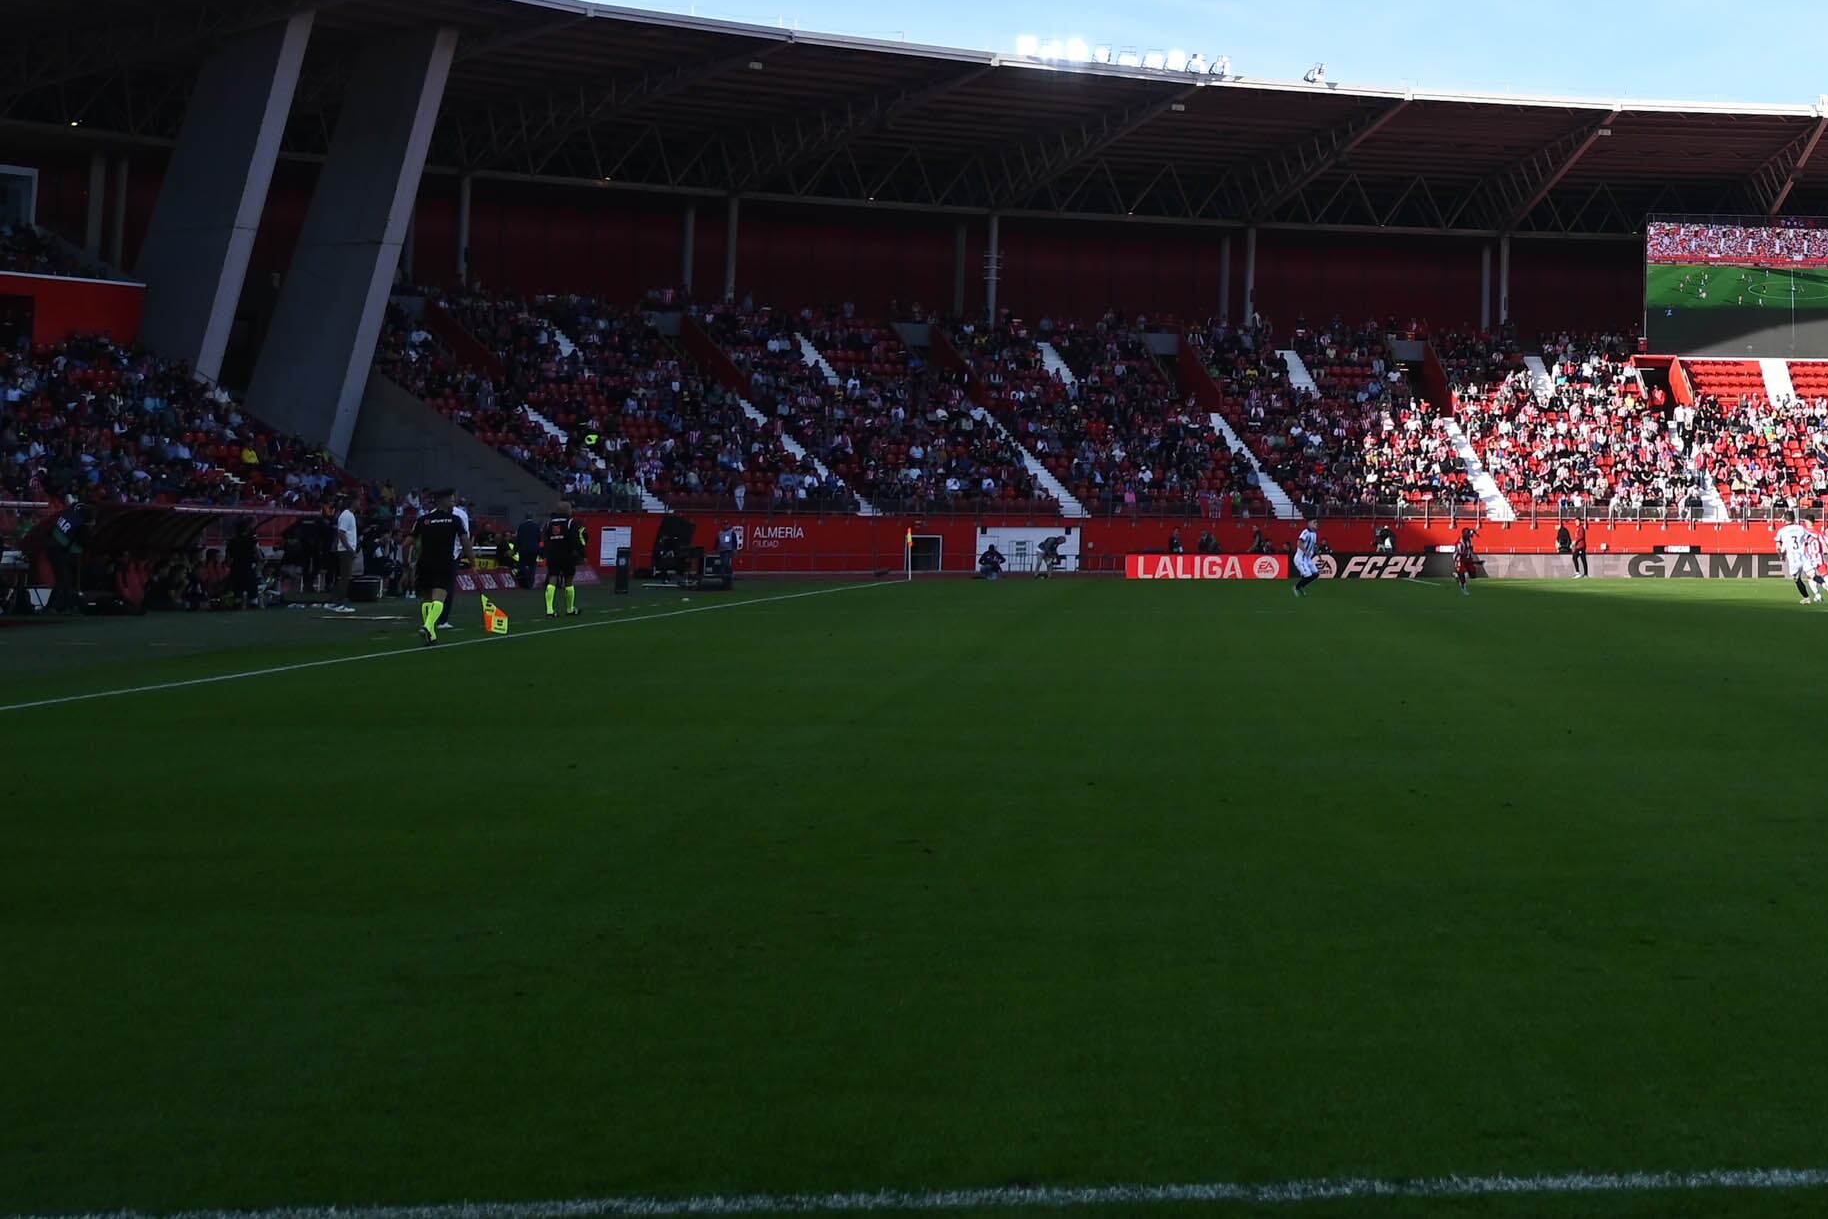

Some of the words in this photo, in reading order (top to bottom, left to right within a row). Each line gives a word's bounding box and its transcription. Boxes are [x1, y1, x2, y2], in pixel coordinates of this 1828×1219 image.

[754, 523, 805, 539] ALMERÍA
[1791, 535, 1800, 550] 3
[1137, 556, 1243, 579] LALIGA
[1258, 561, 1275, 570] EA
[1341, 556, 1426, 579] FC24
[1627, 554, 1786, 578] GAME
